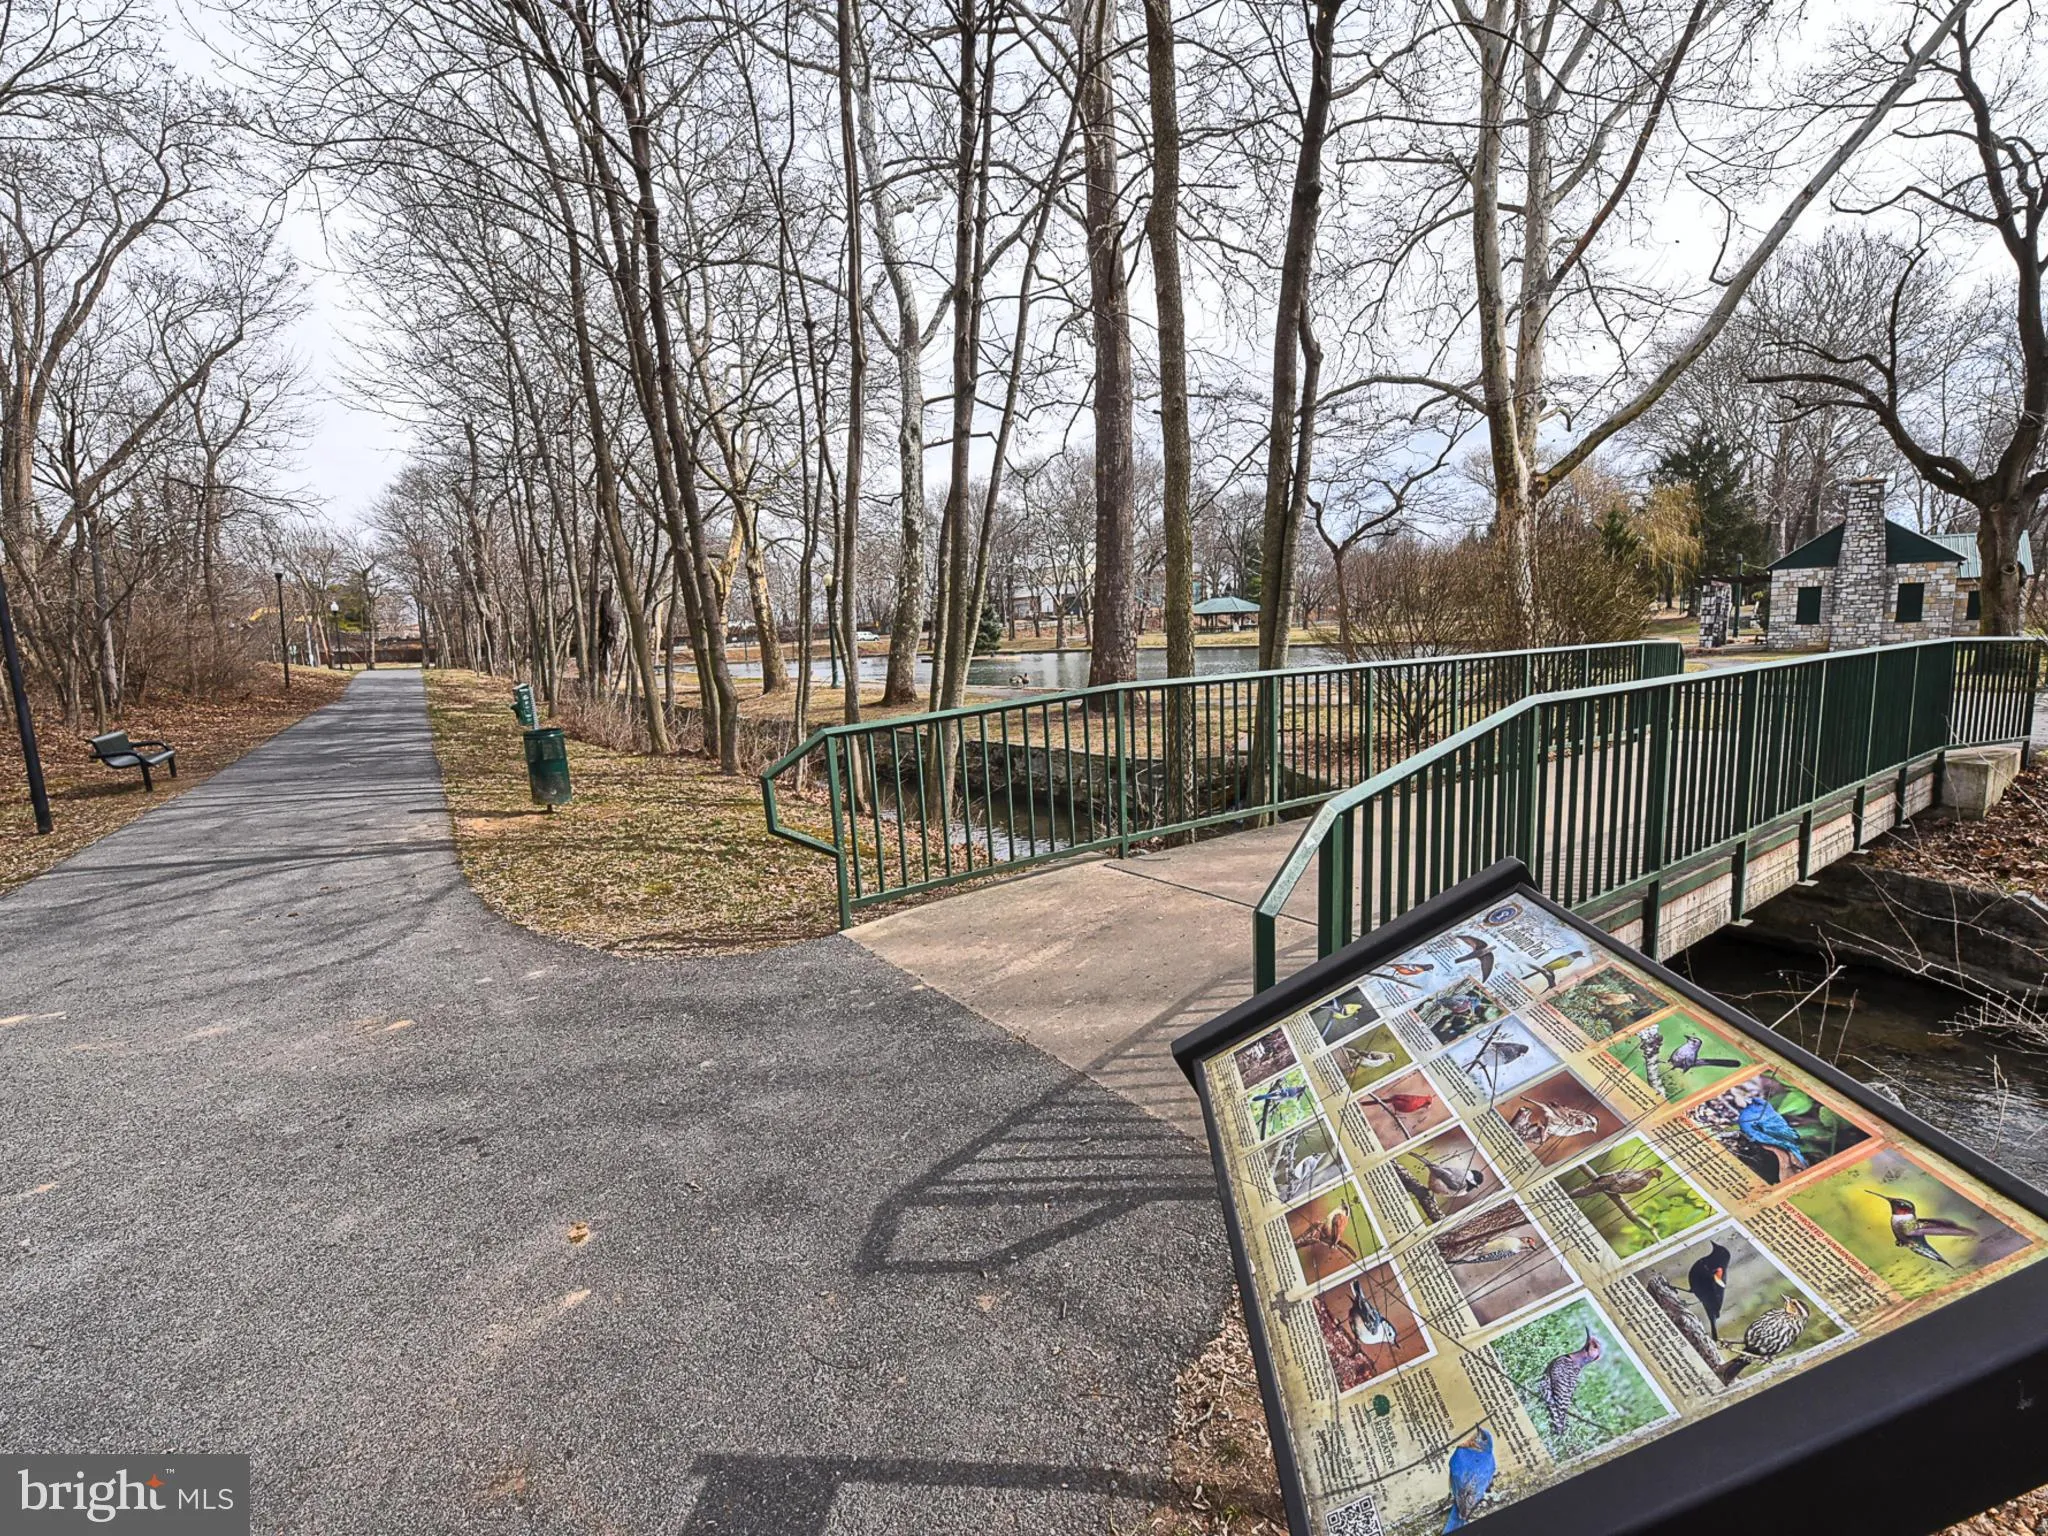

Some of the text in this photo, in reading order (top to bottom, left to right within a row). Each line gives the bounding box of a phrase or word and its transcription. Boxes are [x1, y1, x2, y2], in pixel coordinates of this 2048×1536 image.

[1778, 1200, 1797, 1214] RUBY
[1821, 1236, 1870, 1275] HUMMINGBIRD
[1650, 1306, 1680, 1338] BLACKBIRD
[1372, 1419, 1397, 1469] RECREATION
[1381, 1415, 1400, 1449] PARKS &
